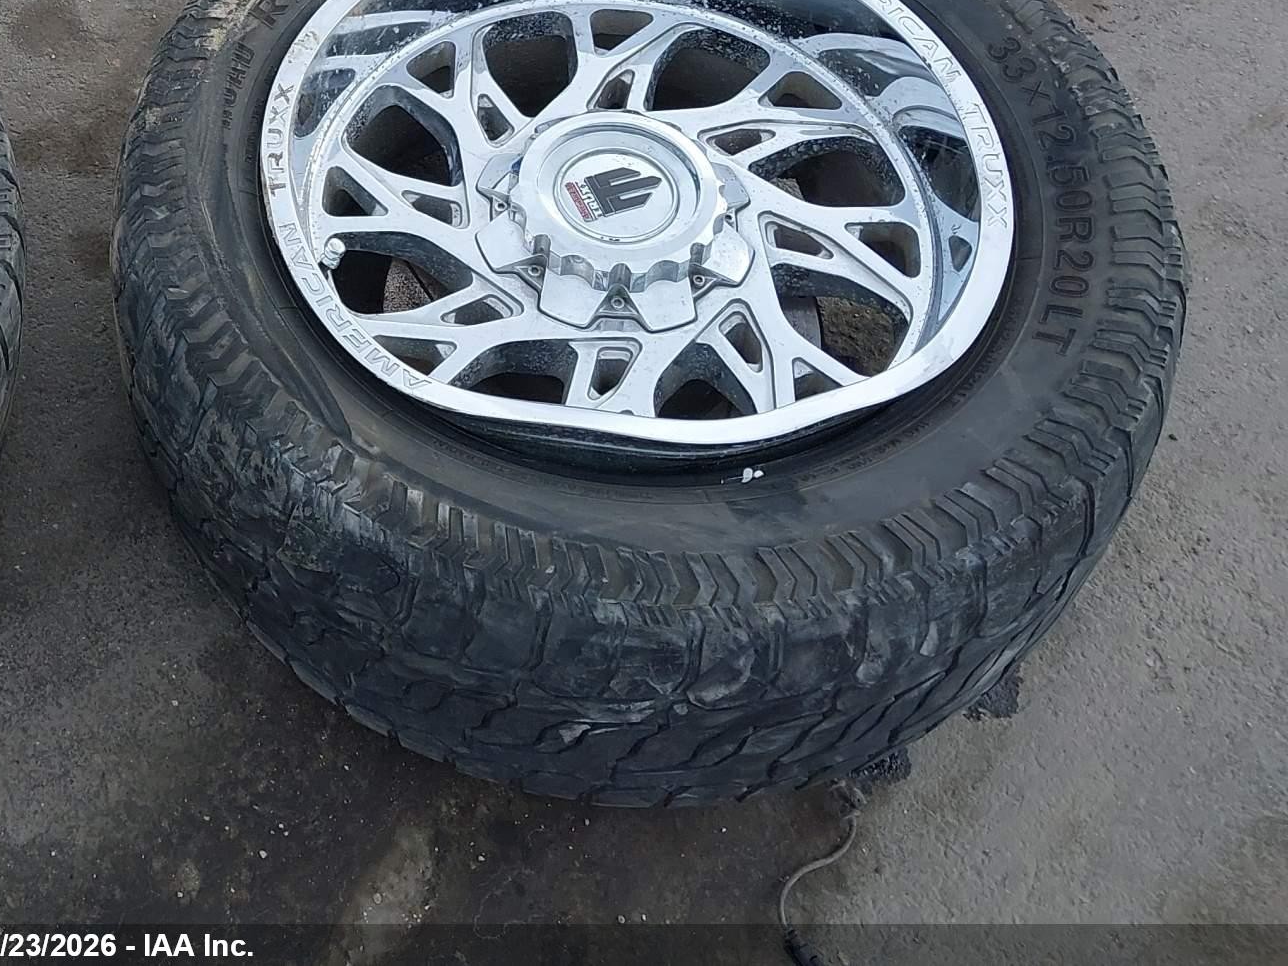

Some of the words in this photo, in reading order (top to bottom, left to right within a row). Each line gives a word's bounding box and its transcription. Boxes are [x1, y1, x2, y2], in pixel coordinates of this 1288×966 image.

[267, 83, 295, 196] TRUXX
[962, 102, 1009, 229] TRUXX
[278, 221, 433, 390] AMERICAN
